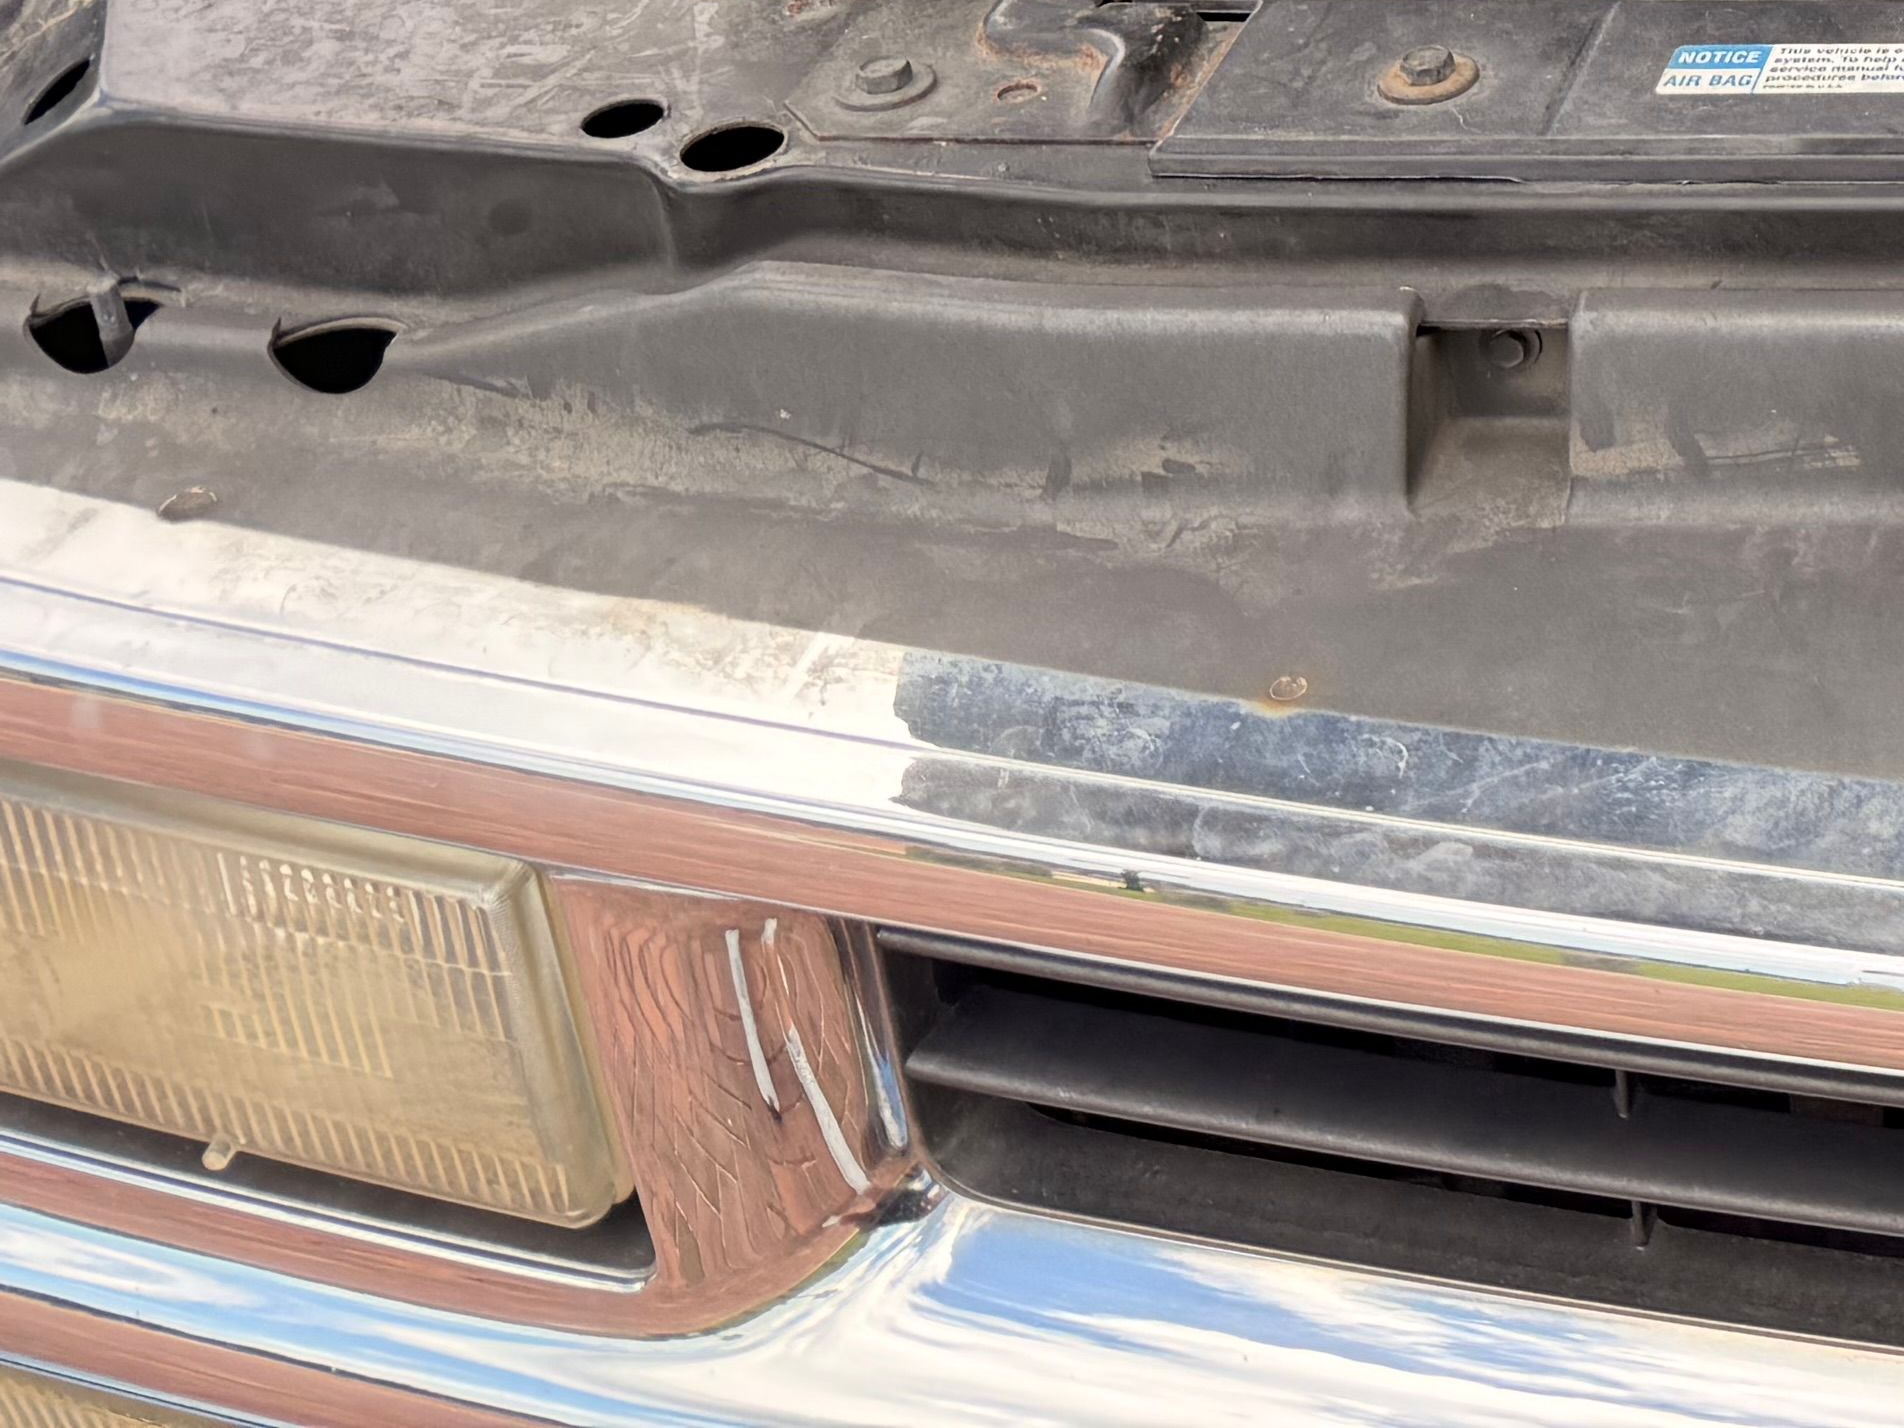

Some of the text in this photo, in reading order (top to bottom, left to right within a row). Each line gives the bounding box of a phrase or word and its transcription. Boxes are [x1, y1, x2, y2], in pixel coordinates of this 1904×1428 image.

[1678, 51, 1761, 64] NOTICE
[1863, 56, 1896, 64] help
[1663, 74, 1753, 86] AIR BAG
[1765, 75, 1856, 83] procedures
